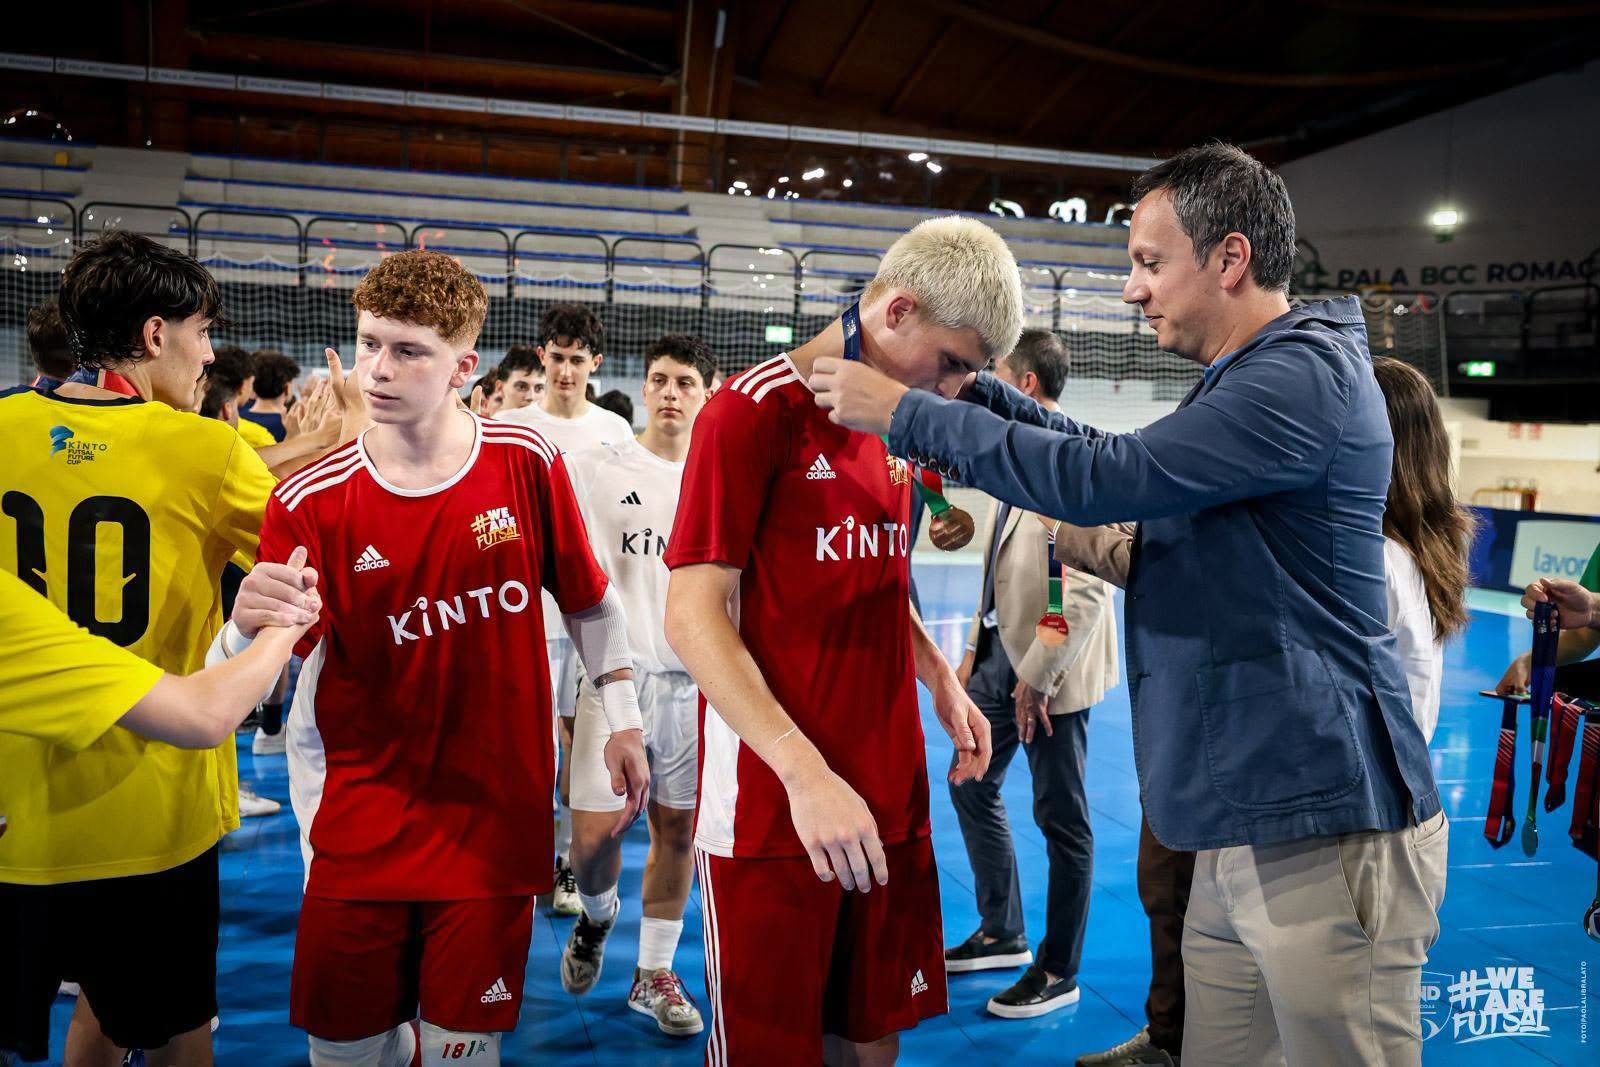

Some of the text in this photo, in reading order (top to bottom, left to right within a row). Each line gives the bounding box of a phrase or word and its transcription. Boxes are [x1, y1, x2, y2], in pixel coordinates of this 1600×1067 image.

[1421, 265, 1477, 285] BCC
[67, 448, 95, 456] FUTSAL
[67, 454, 95, 462] FUTURE
[806, 469, 837, 479] adidas
[476, 525, 521, 550] FUTSAL
[2, 490, 151, 647] 10
[354, 559, 390, 572] adidas
[480, 992, 512, 1003] adidas
